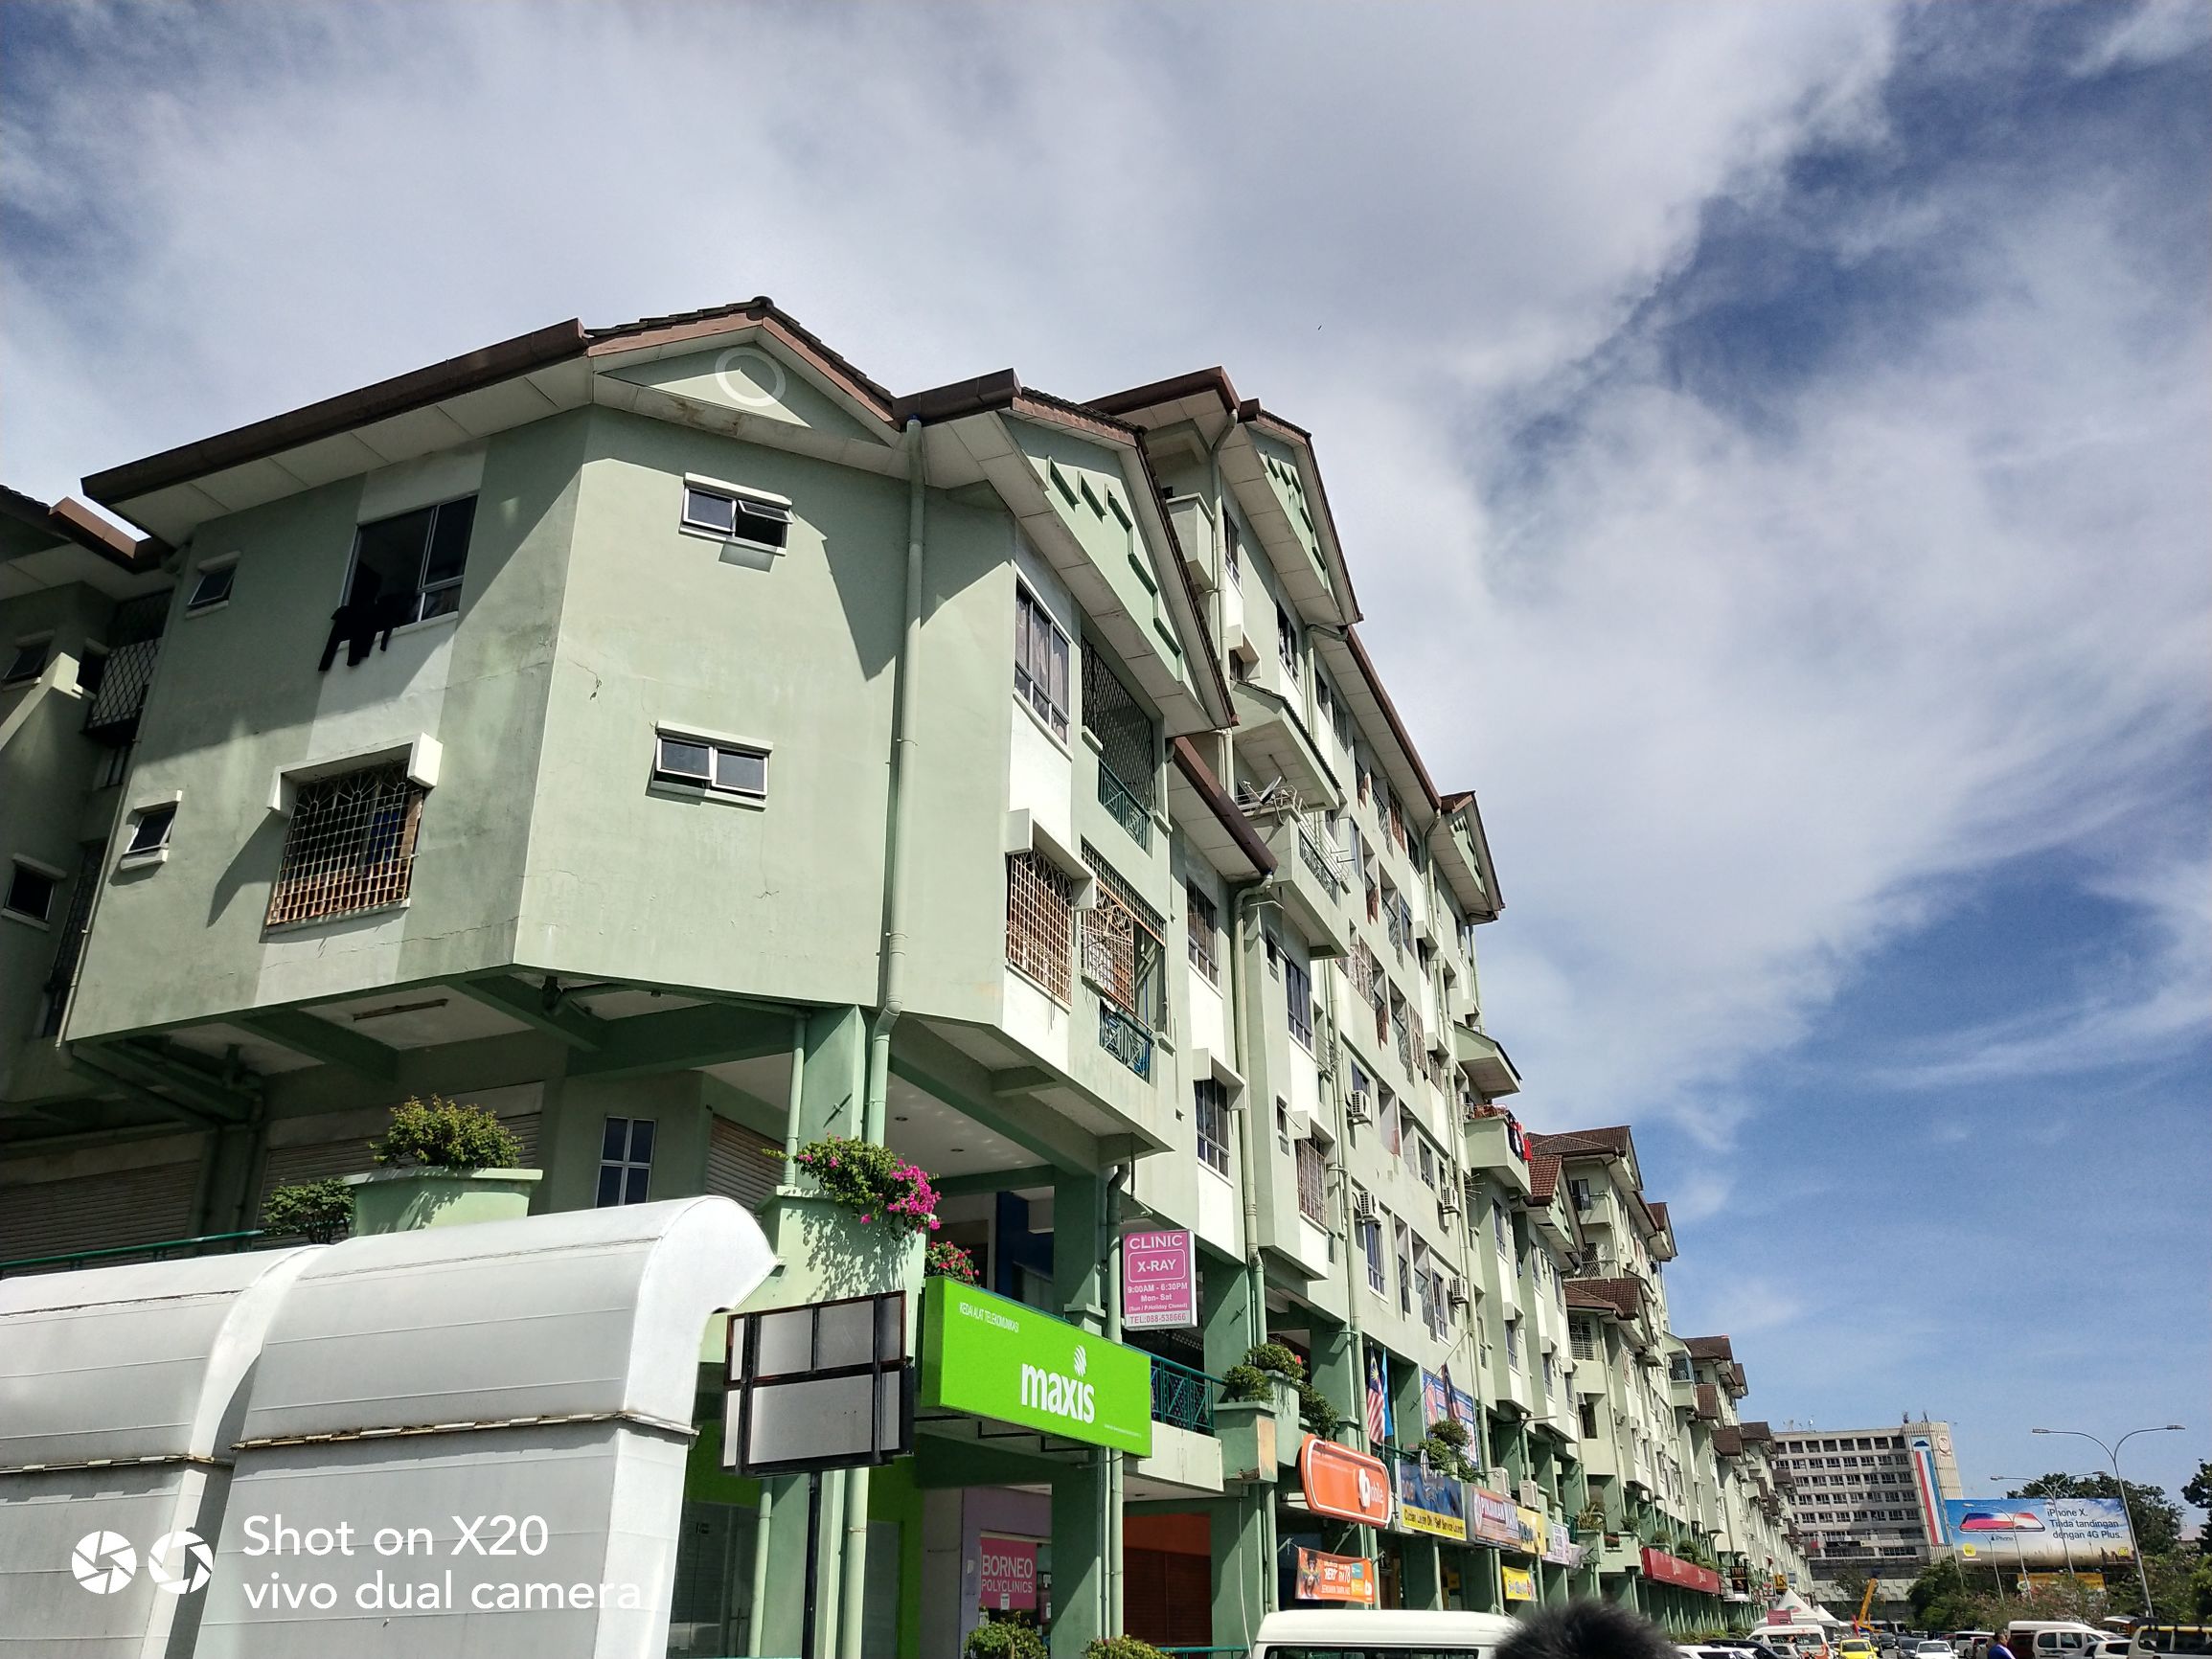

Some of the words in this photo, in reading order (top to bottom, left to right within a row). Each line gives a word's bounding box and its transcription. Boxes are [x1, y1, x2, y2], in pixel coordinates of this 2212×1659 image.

[1129, 1235, 1183, 1250] CLINIC
[1137, 1259, 1176, 1272] X-RAY
[1128, 1284, 1154, 1293] 9:00AM
[1160, 1282, 1188, 1291] 6:30PM
[1021, 1363, 1095, 1424] maxis
[2076, 1519, 2119, 1530] tandingan
[2052, 1531, 2086, 1540] dengan
[982, 1554, 1033, 1579] BORNEO
[981, 1579, 1033, 1594] POLYCLINICS
